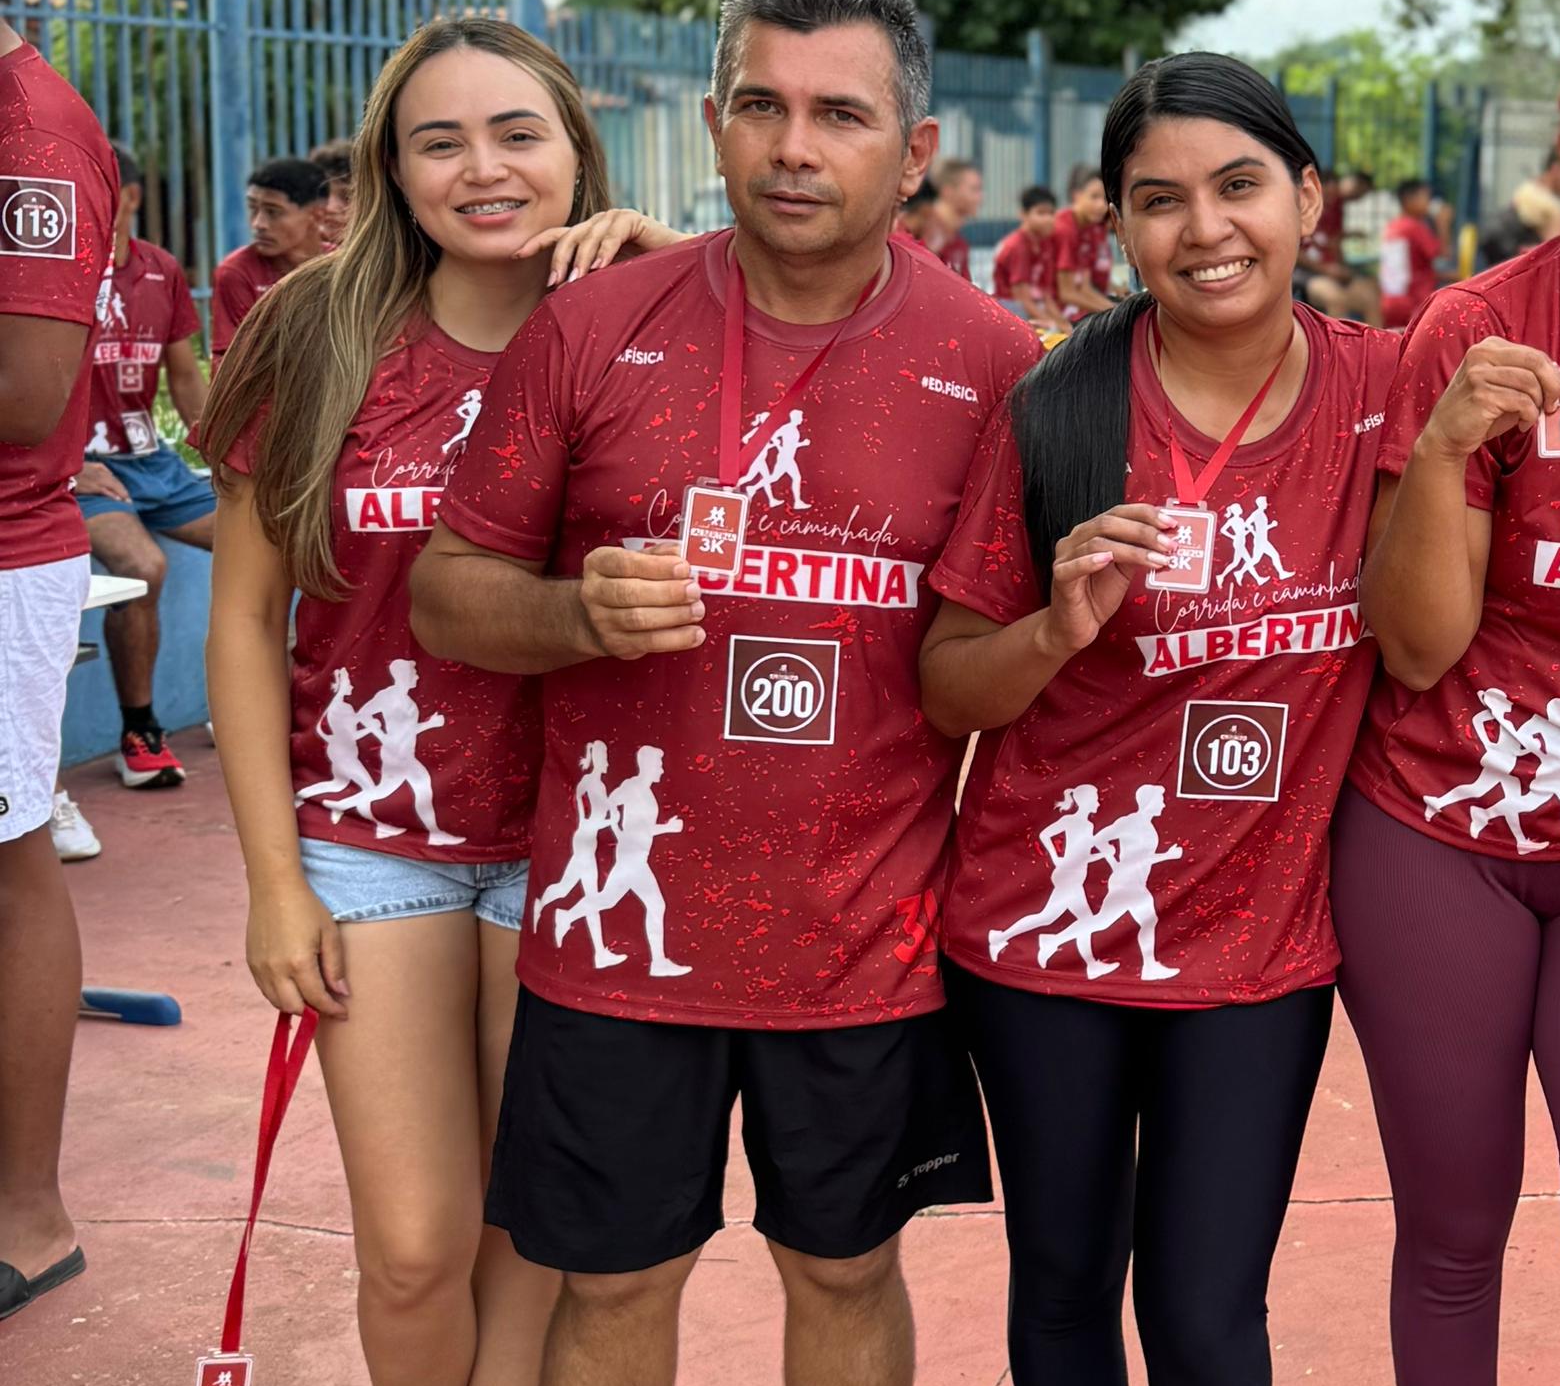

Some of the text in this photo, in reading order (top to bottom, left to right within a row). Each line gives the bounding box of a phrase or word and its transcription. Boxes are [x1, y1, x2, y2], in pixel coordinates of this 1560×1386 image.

[13, 207, 59, 238] 113
[699, 538, 725, 554] 3K
[779, 504, 900, 556] caminhada
[1167, 555, 1192, 571] 3K
[1155, 582, 1248, 635] Corrida
[751, 678, 815, 719] 200
[1207, 738, 1262, 777] 103
[912, 1153, 960, 1176] Topper
